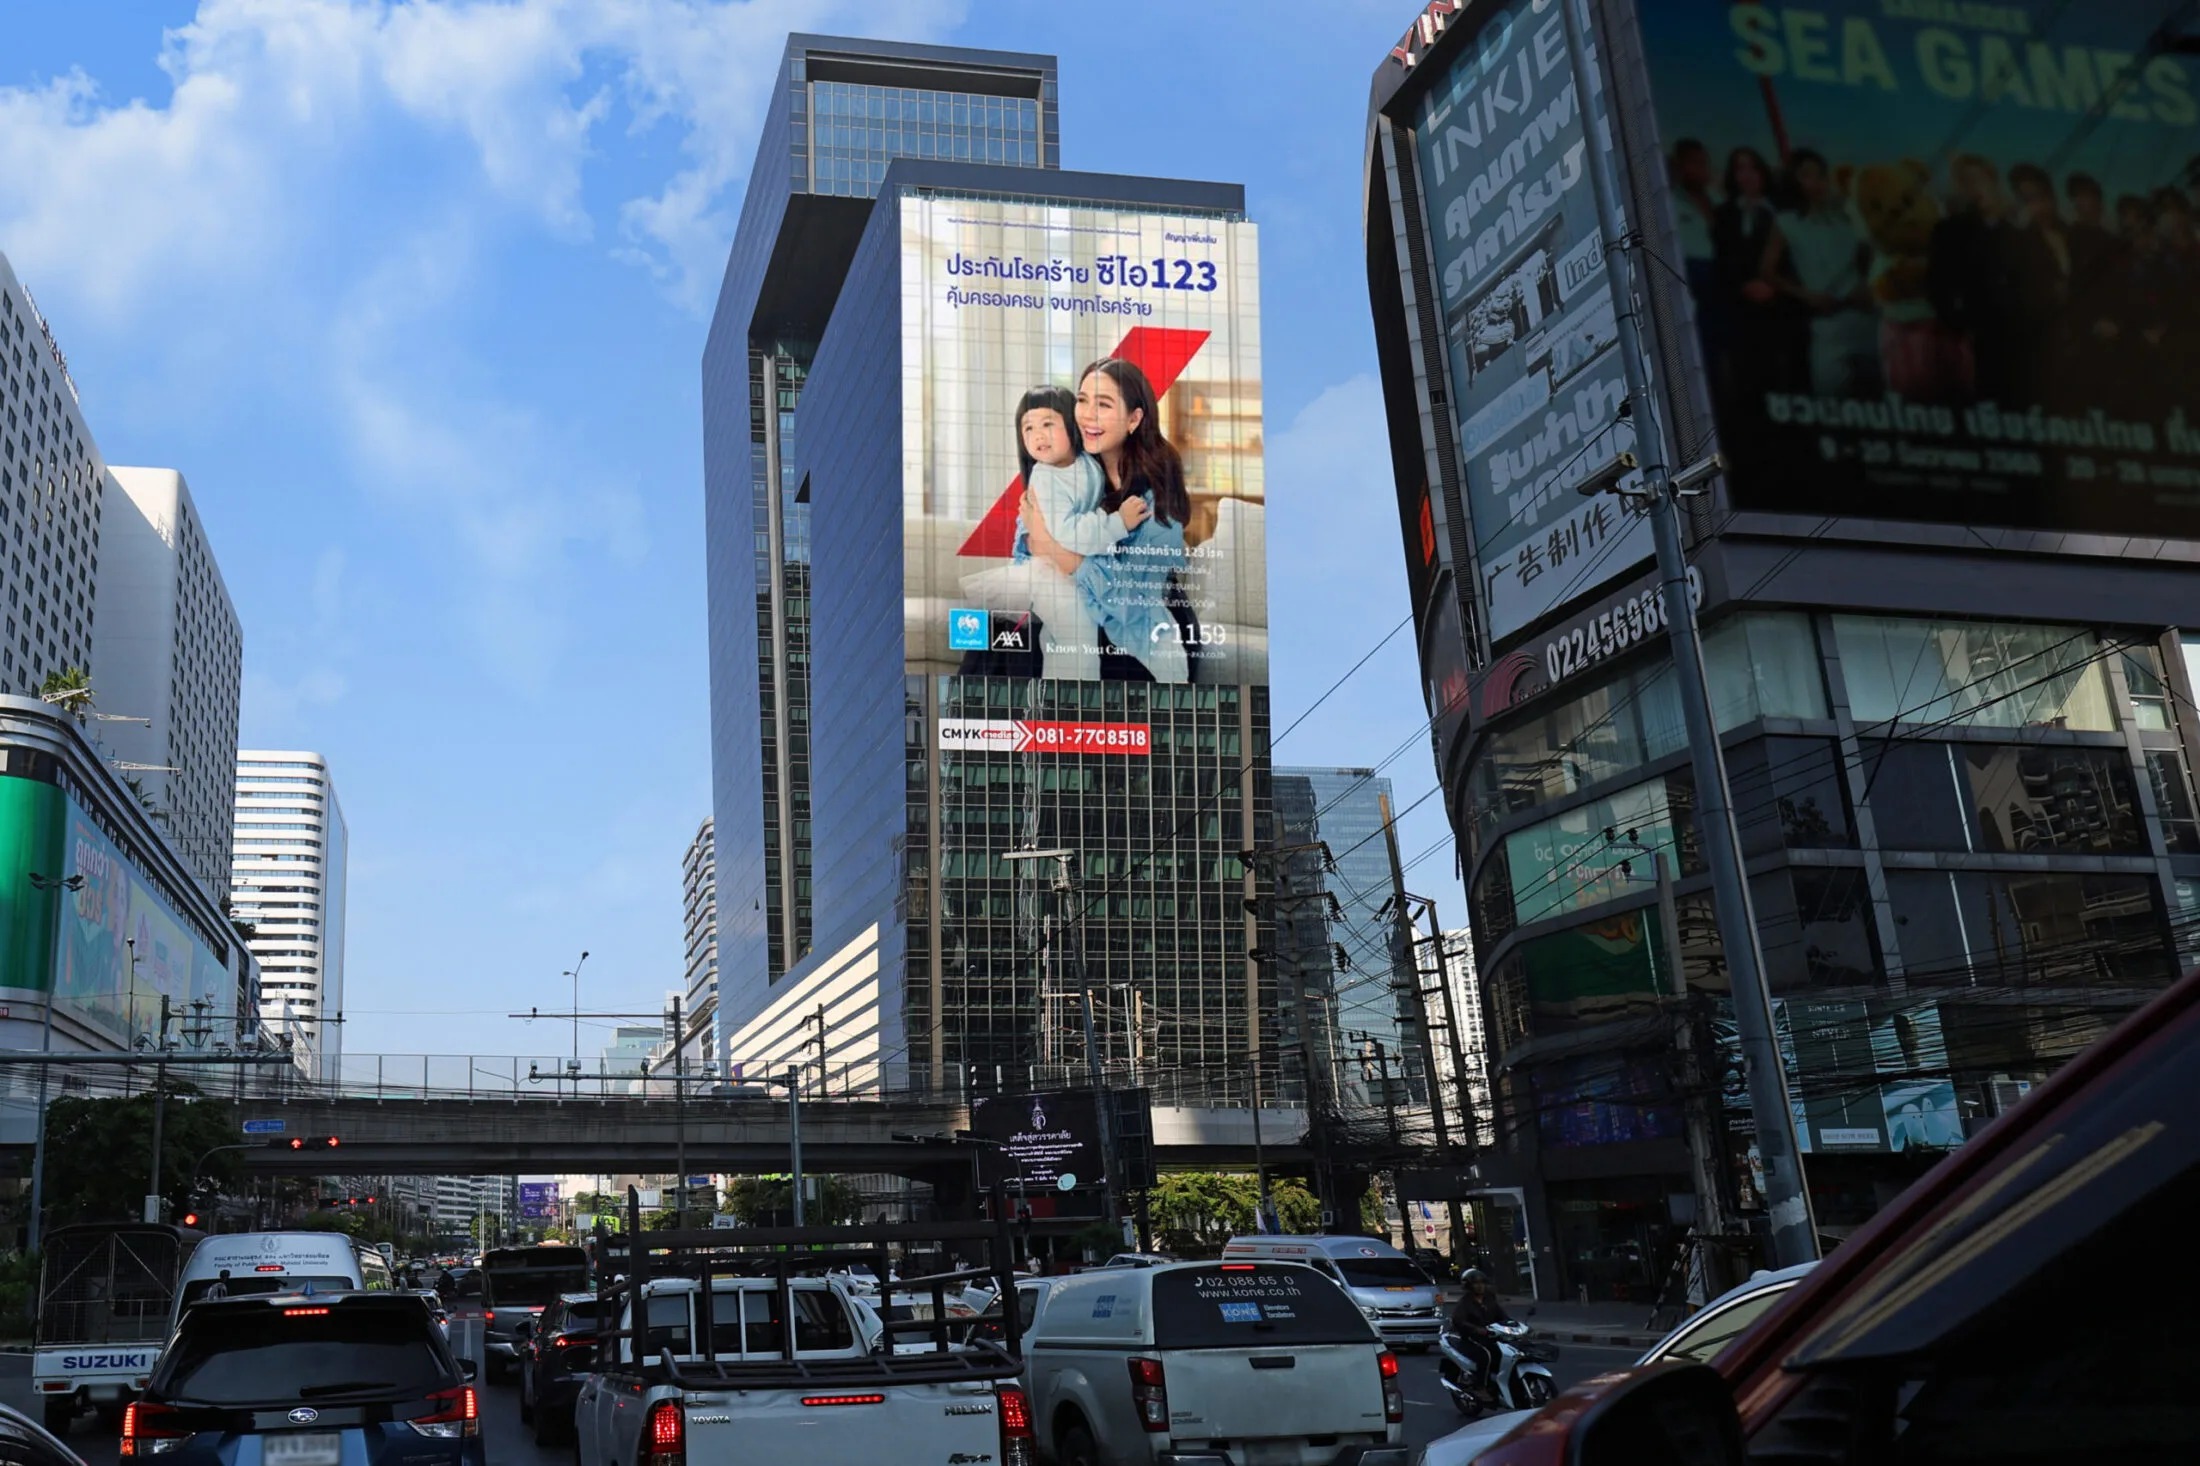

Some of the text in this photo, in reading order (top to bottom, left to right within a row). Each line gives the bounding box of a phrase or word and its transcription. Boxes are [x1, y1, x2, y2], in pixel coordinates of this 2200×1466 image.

[1730, 2, 2198, 126] SEA GAMES
[947, 252, 1217, 292] ประกันโรคร้าย ซีไอ123
[947, 285, 1152, 318] คุ้มครองครบ จบทุกโรคร้าย
[1185, 547, 1204, 558] 123
[992, 631, 1024, 648] AXA
[1173, 623, 1226, 645] 1159
[1046, 642, 1128, 656] Know You Can
[942, 727, 982, 740] CMYK
[1035, 727, 1146, 746] 081-7708518
[1206, 1277, 1225, 1287] 02
[1228, 1276, 1255, 1286] 088
[1199, 1286, 1301, 1299] www.kone.co.th
[63, 1354, 146, 1369] SUZUKI
[944, 1403, 992, 1416] HILUX
[691, 1414, 731, 1425] TOYOTA
